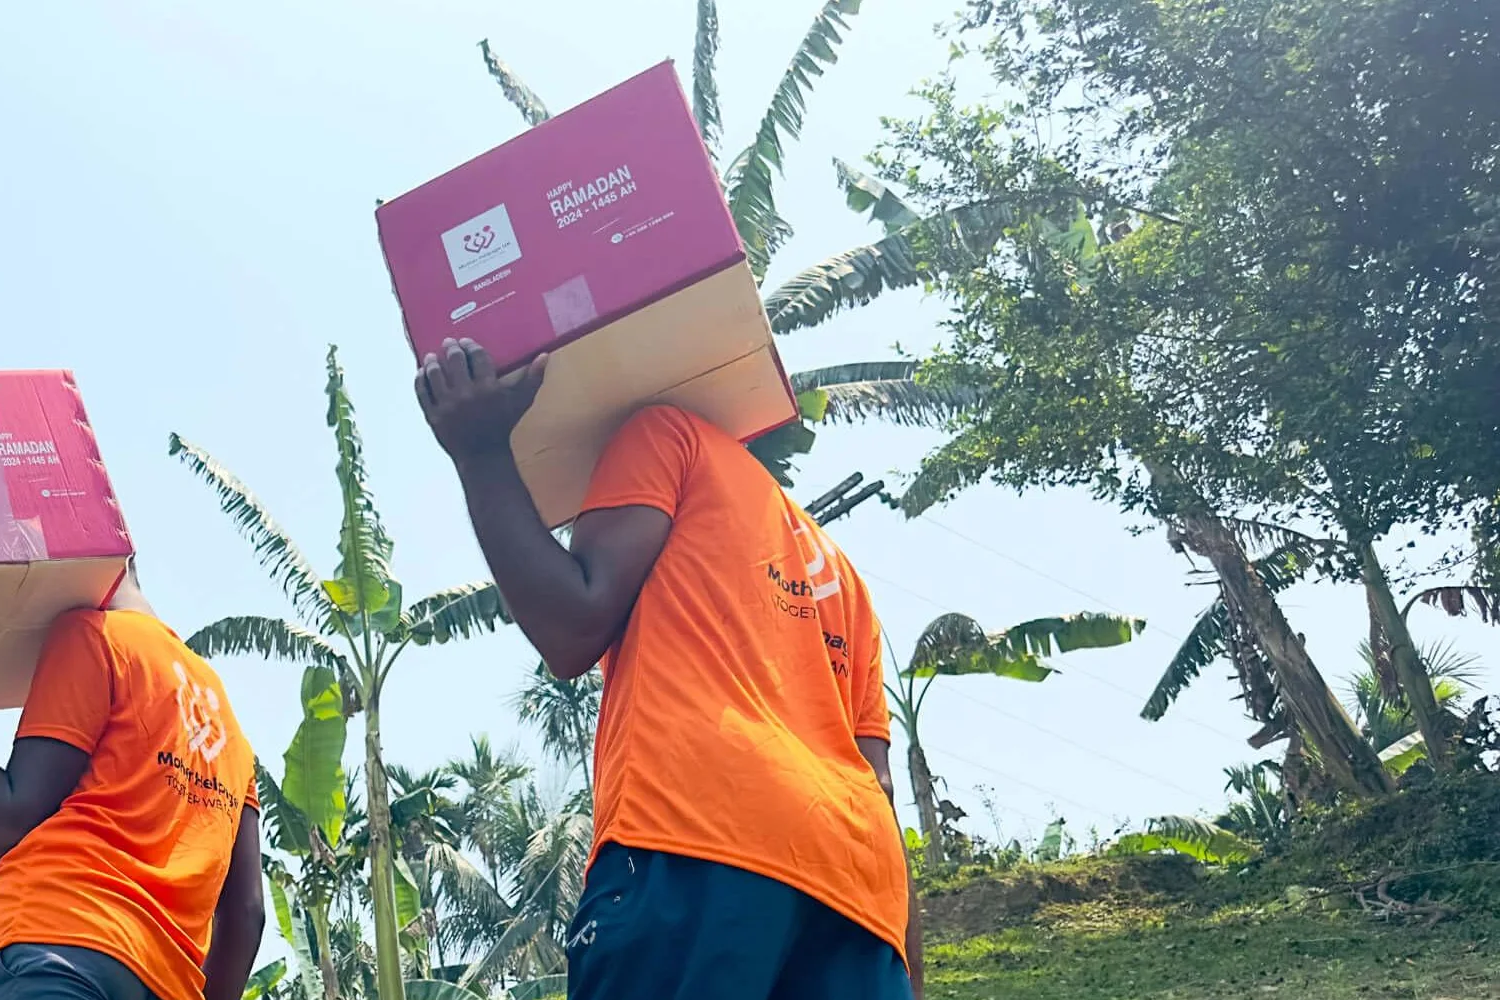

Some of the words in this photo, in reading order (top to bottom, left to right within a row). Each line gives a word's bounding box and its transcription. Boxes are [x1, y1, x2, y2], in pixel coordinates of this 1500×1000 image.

[546, 180, 573, 200] HAPPY
[550, 164, 632, 217] RAMADAN
[557, 208, 583, 229] 2024
[591, 191, 618, 211] 1445
[619, 181, 637, 198] AH
[2, 456, 21, 467] 2024
[26, 456, 46, 466] 1445
[767, 563, 814, 597] Moth
[774, 593, 816, 620] TOGET
[157, 750, 194, 783] Mohr
